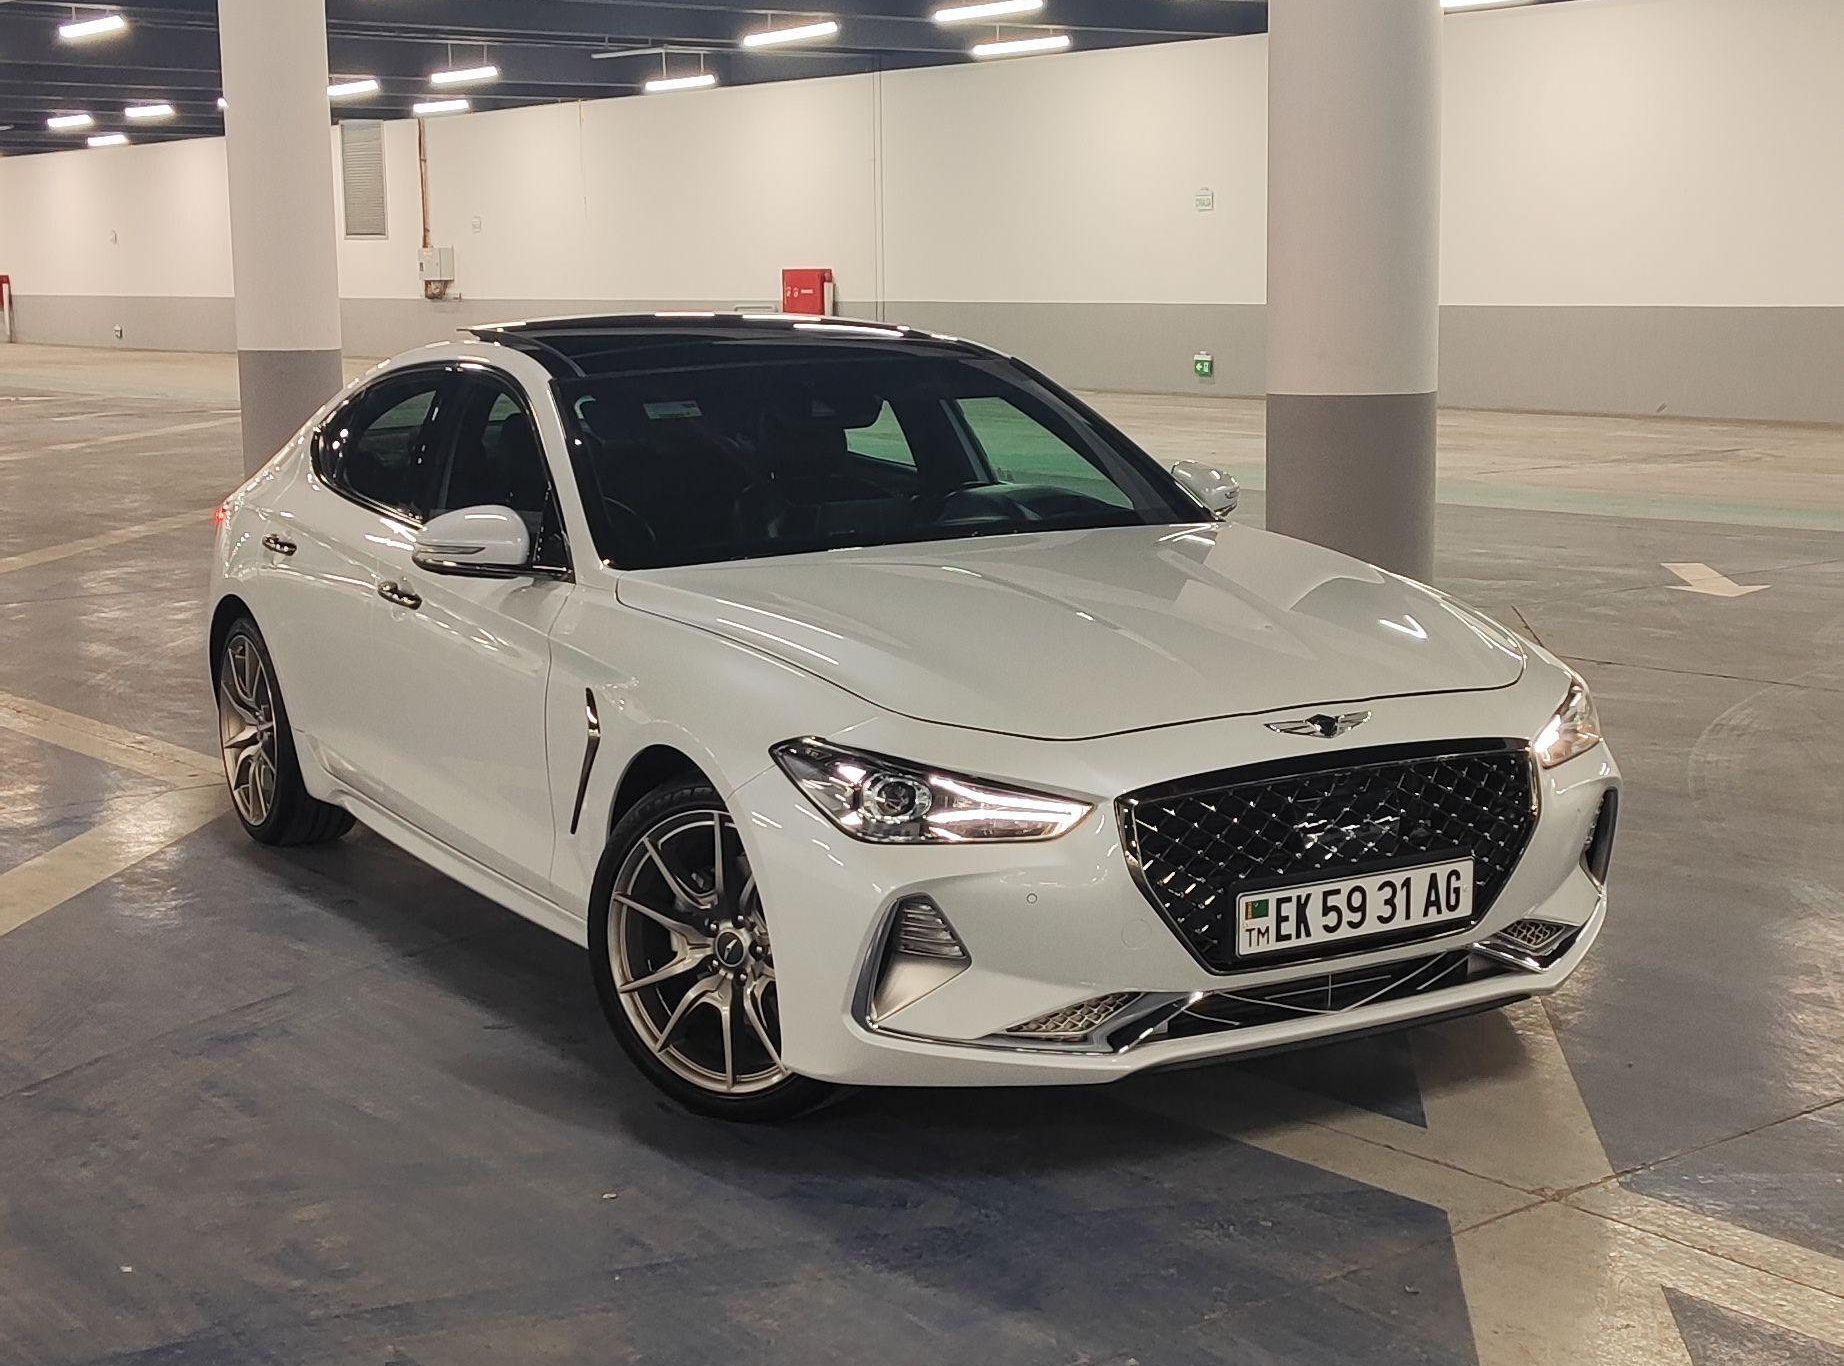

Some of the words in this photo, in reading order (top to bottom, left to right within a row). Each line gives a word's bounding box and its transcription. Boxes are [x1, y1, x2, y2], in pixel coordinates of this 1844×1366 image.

[1275, 893, 1312, 942] EK
[1321, 885, 1367, 934] 59
[1376, 877, 1412, 925] 31
[1422, 869, 1461, 918] AG
[1245, 925, 1270, 948] TM
